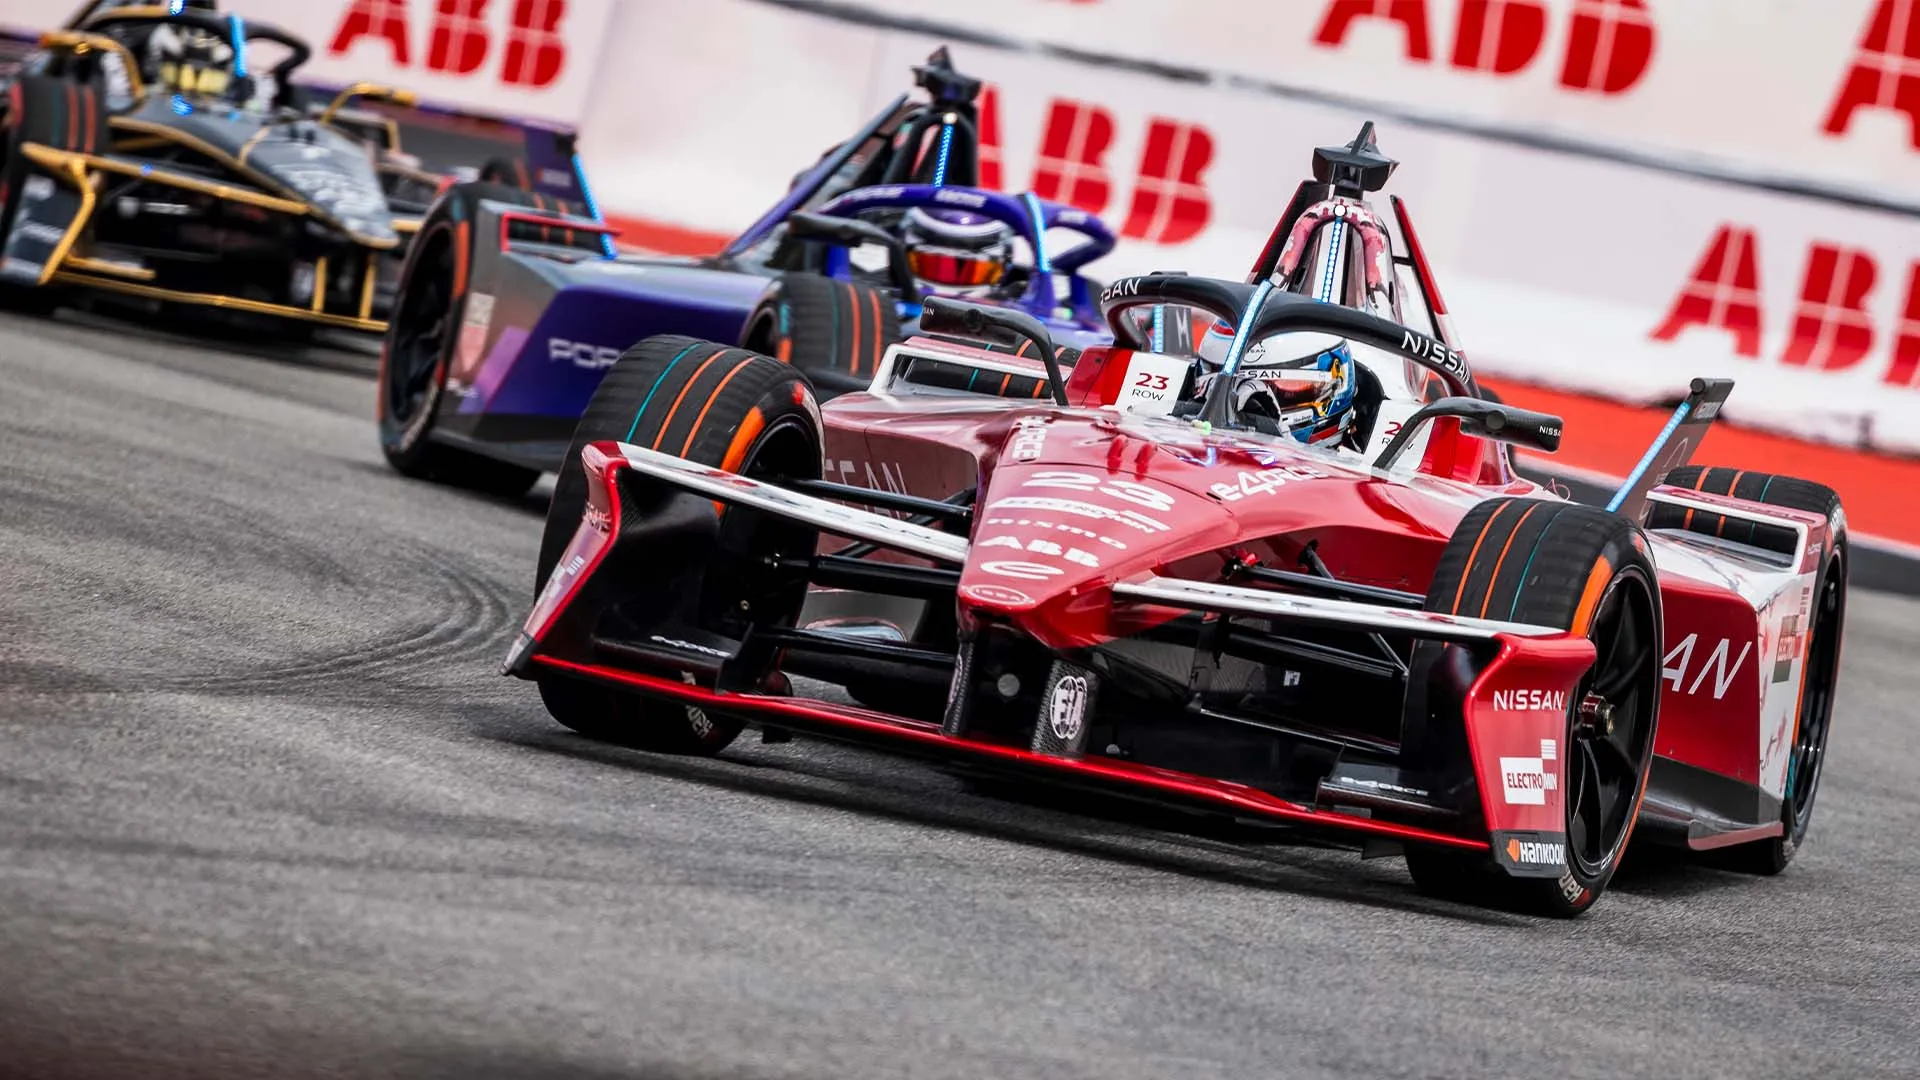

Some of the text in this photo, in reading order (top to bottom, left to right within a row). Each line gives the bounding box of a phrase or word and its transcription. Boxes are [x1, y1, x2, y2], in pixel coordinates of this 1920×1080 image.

[1135, 372, 1170, 390] 23
[1132, 389, 1165, 401] ROW
[1022, 471, 1175, 512] 23
[979, 535, 1100, 567] ABB
[1493, 689, 1565, 711] NISSAN
